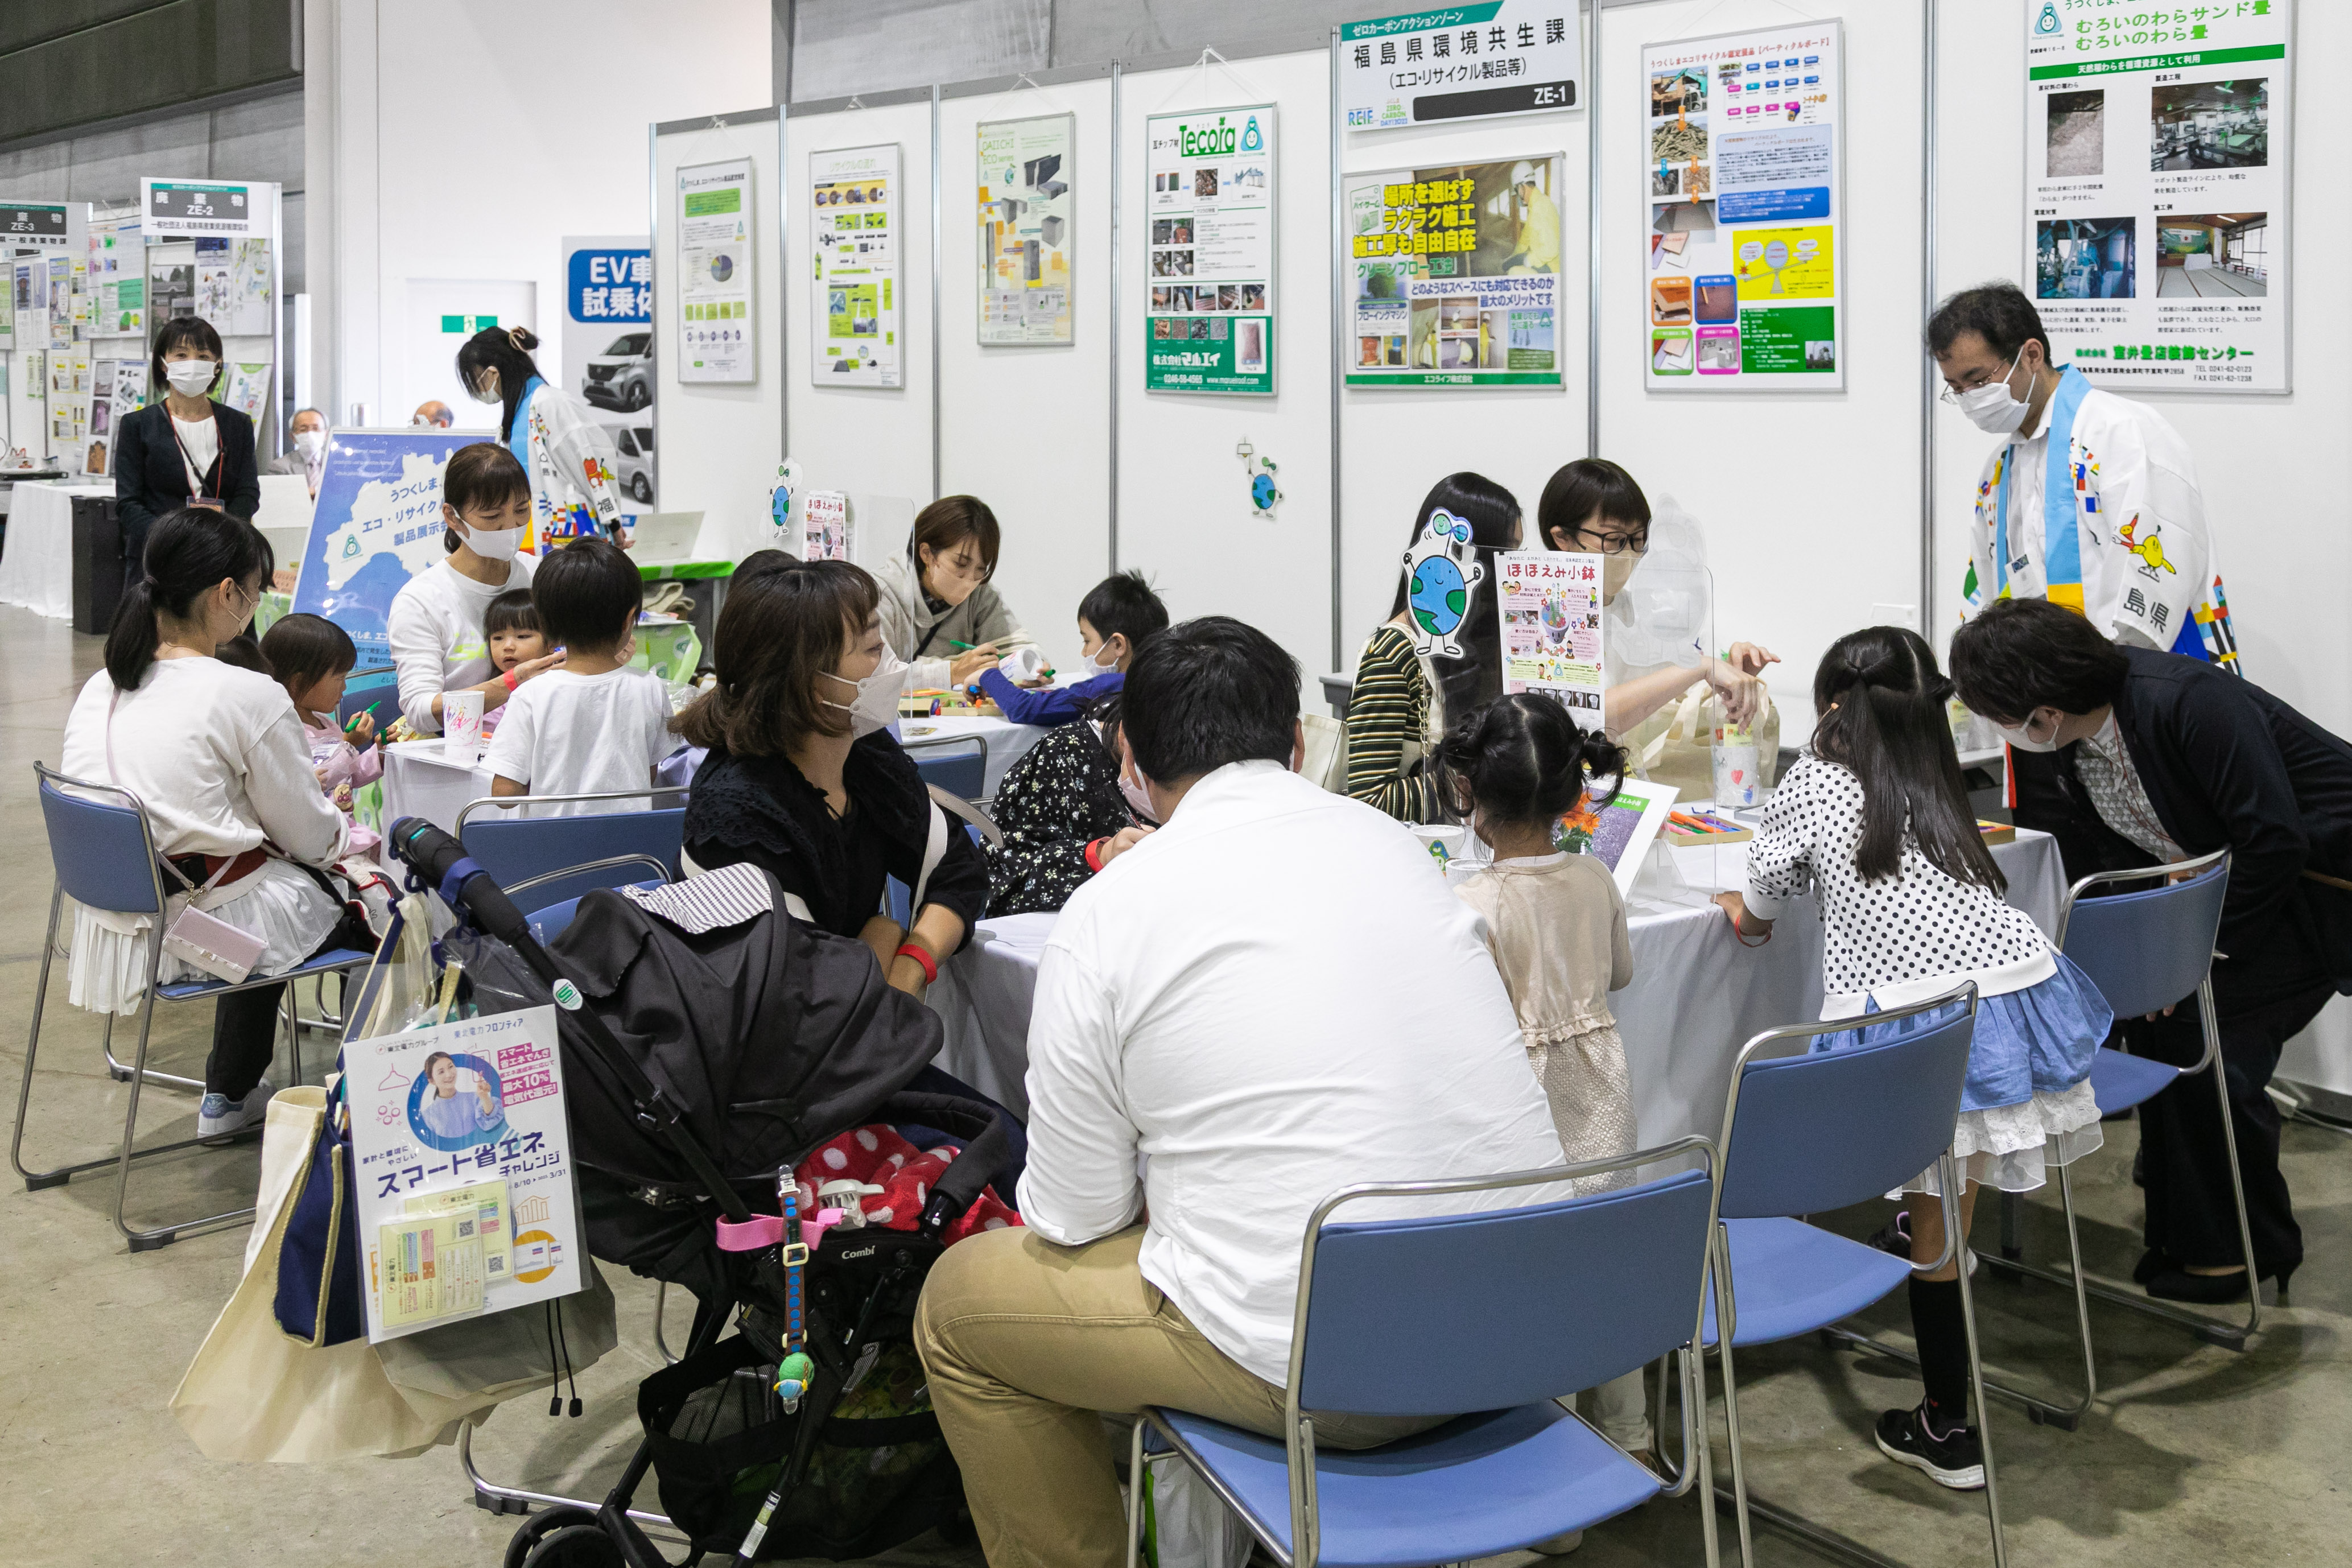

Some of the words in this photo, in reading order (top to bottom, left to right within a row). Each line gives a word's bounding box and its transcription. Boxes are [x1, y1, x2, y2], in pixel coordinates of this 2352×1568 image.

[1352, 11, 1464, 36] ゼロカーボンアクションゾーン
[1354, 18, 1565, 69] 福島県環境共生課
[1534, 85, 1566, 105] ZE-1
[1179, 125, 1235, 157] Tecora
[155, 191, 245, 207] 廃棄物
[1384, 178, 1475, 208] 場所を選ばず
[187, 205, 214, 216] ZE-2
[1384, 203, 1476, 232] ラクラク施工
[10, 222, 35, 231] ZE-3
[1353, 228, 1476, 258] 施工厚も自由自在
[598, 497, 614, 514] 福
[1508, 563, 1595, 581] ほほえみ小鉢
[2123, 587, 2170, 634] 島県
[500, 1045, 531, 1059] スマート
[500, 1049, 550, 1068] 省エネでんき
[503, 1073, 548, 1093] 最大10%
[378, 1132, 545, 1198] スマート省エネ
[388, 1153, 417, 1166] やさしい
[499, 1150, 560, 1177] チャレンジ
[514, 1178, 531, 1188] 8/10
[550, 1169, 566, 1178] 3/31
[841, 1245, 876, 1260] Combi
